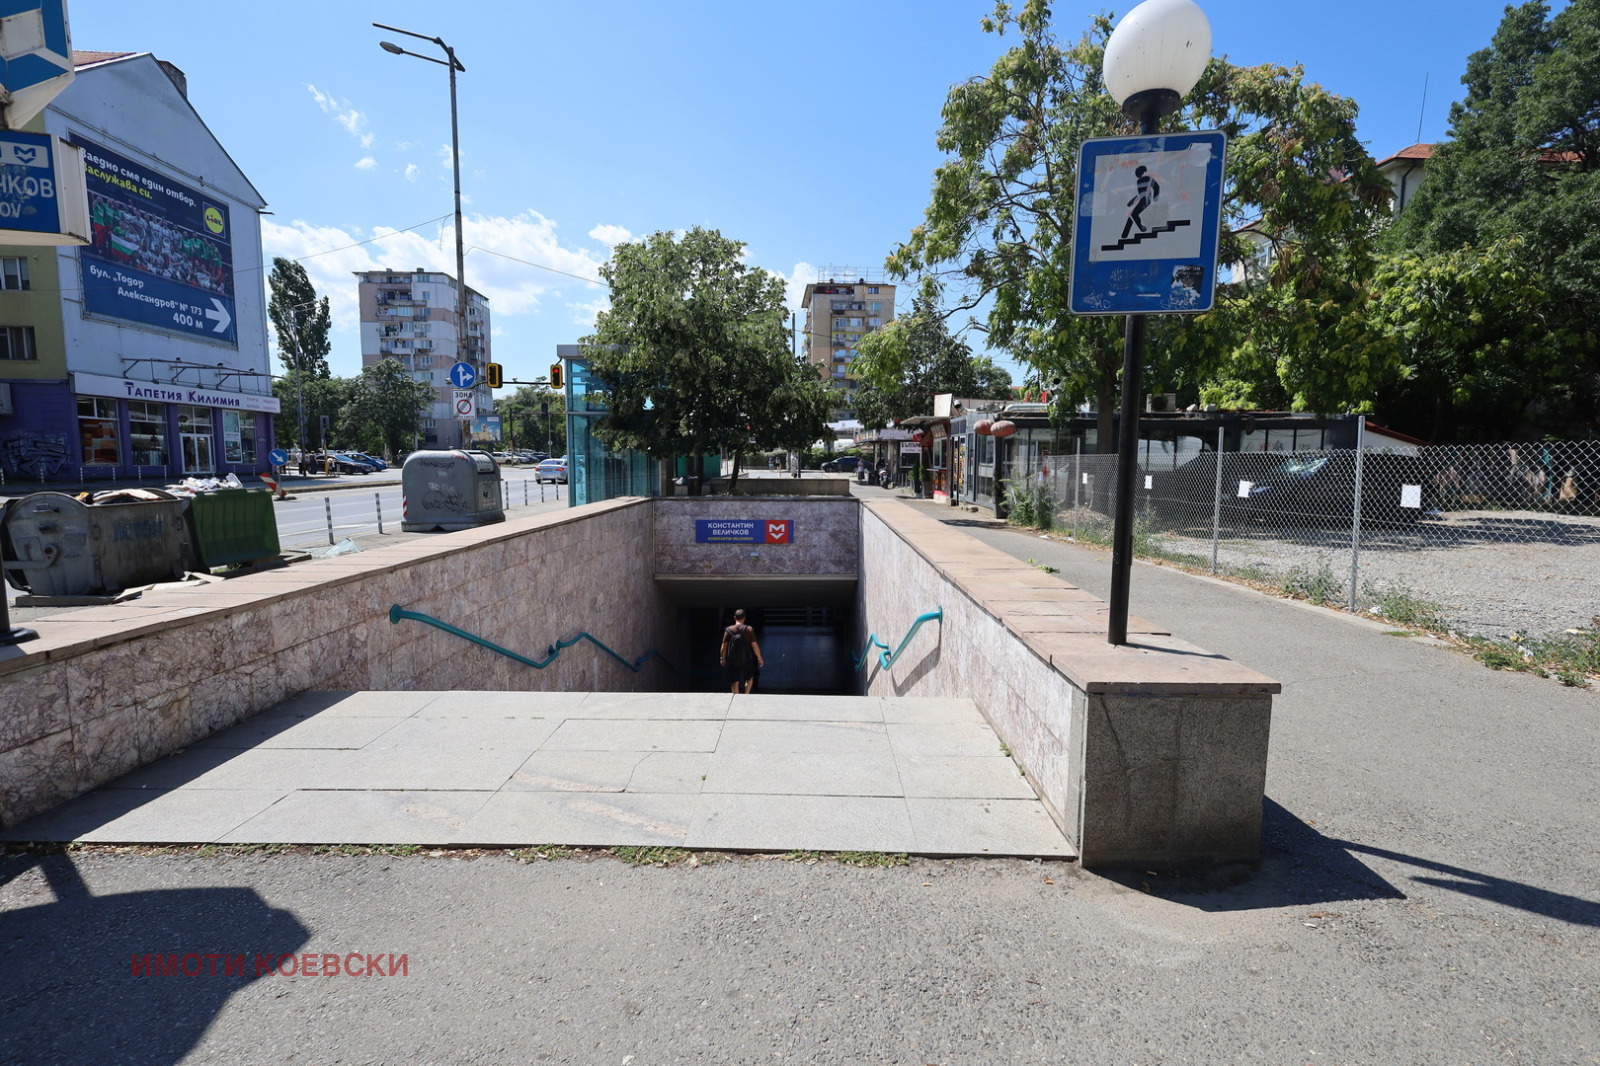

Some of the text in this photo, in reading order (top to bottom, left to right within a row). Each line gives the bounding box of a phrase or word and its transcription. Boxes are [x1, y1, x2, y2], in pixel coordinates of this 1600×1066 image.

[120, 168, 140, 182] сме
[142, 177, 165, 193] един
[165, 187, 197, 208] отбор.
[139, 188, 153, 199] си.
[90, 264, 112, 279] бул.
[190, 305, 203, 316] 173
[173, 312, 194, 327] 400
[188, 391, 240, 407] КИЛИМИЯ
